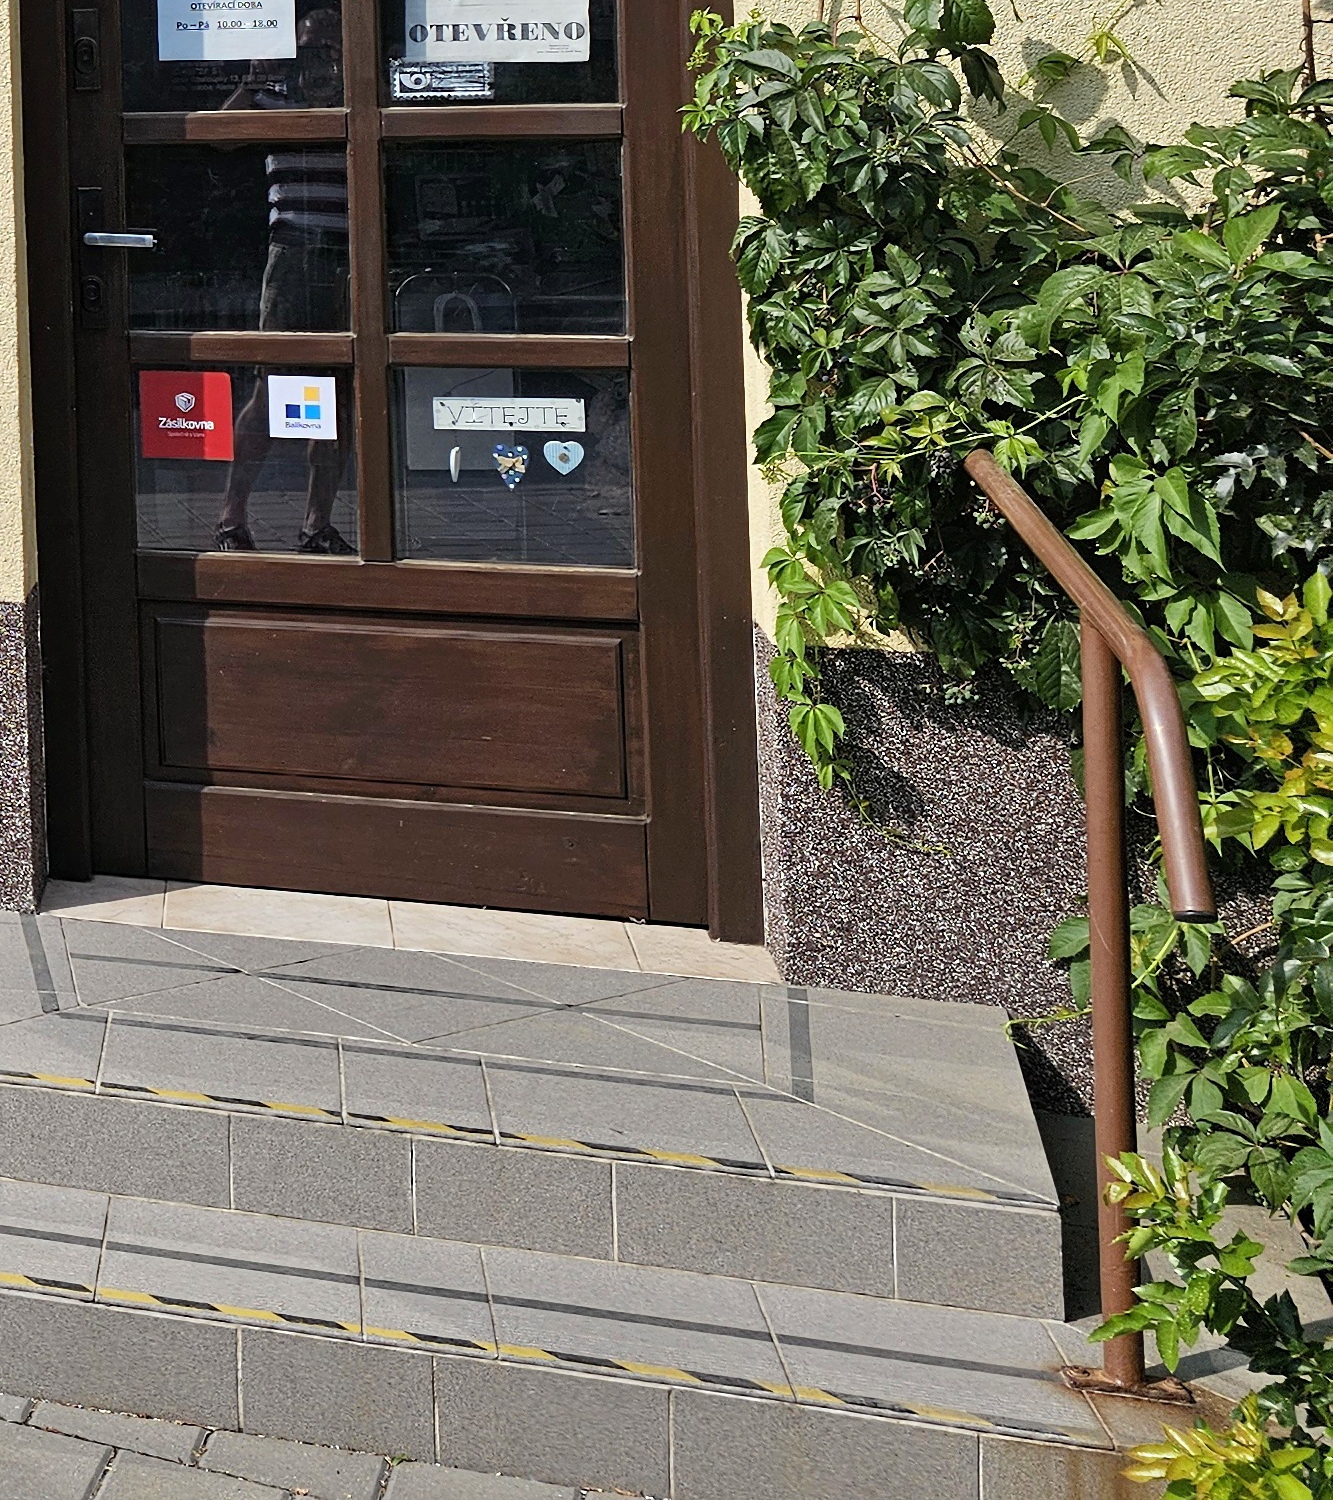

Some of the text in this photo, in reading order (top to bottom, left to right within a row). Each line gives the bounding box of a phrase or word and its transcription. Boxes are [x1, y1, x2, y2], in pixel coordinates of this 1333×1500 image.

[190, 0, 263, 10] OTEVÍRACÍ DOBA
[409, 17, 585, 43] OTEVŘENO
[158, 417, 215, 431] Zásilkovna
